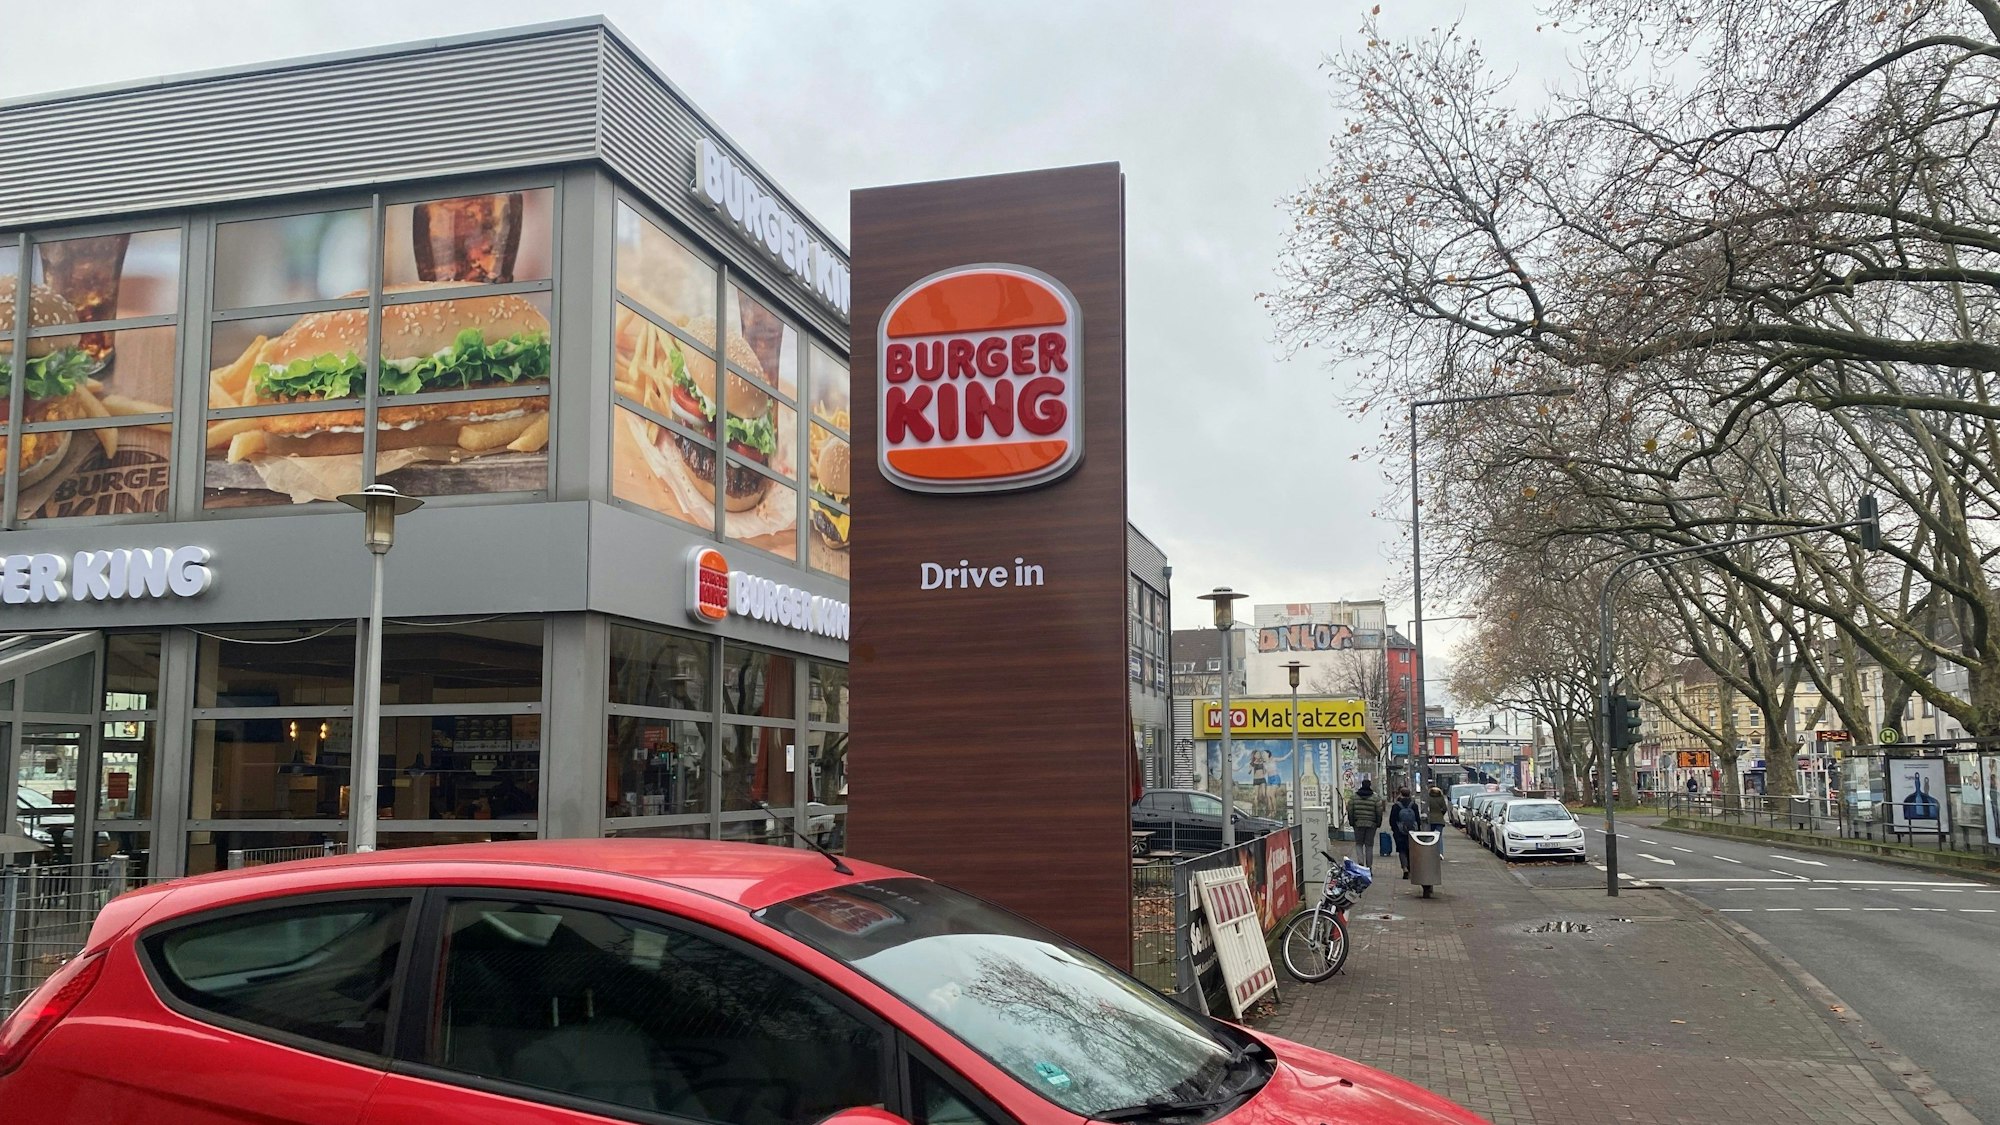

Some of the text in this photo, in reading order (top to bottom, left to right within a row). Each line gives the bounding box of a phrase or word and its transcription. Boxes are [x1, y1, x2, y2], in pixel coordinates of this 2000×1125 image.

[696, 138, 811, 284] BURGER
[886, 332, 1068, 383] BURGER
[886, 376, 1067, 444] KING
[54, 467, 169, 503] BURGE
[0, 545, 212, 604] ER KING
[700, 569, 728, 588] BURGER
[700, 582, 728, 608] KING
[921, 557, 1044, 590] Drive in
[730, 571, 813, 632] BURGER
